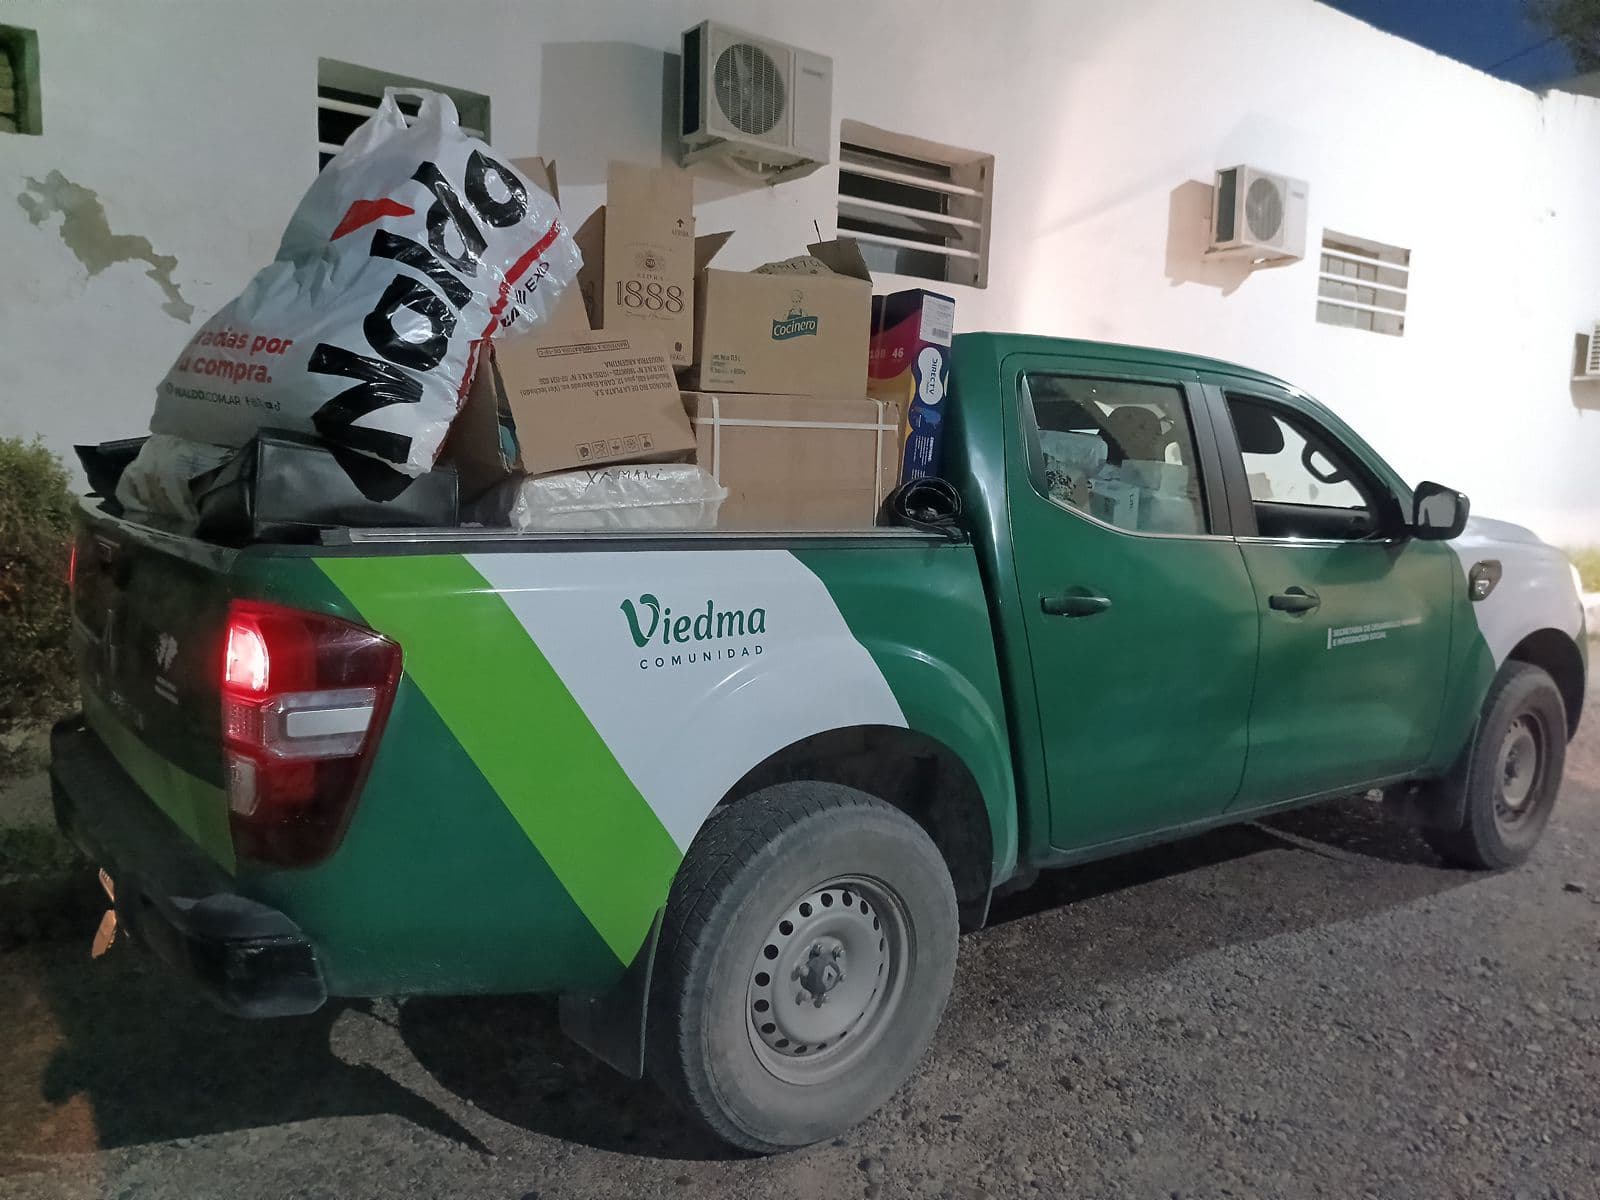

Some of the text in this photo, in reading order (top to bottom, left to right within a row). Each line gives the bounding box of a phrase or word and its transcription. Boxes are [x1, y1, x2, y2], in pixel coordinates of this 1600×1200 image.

[615, 280, 685, 314] 1888
[773, 319, 816, 338] Cocinero
[250, 334, 293, 356] por
[892, 347, 904, 359] 46
[179, 357, 272, 384] u compra.
[604, 358, 635, 368] ARGENTINA
[926, 357, 938, 395] DIRECTV
[604, 386, 622, 395] PLATA
[619, 593, 767, 648] Viedma
[639, 645, 763, 670] COMUNIDAD
